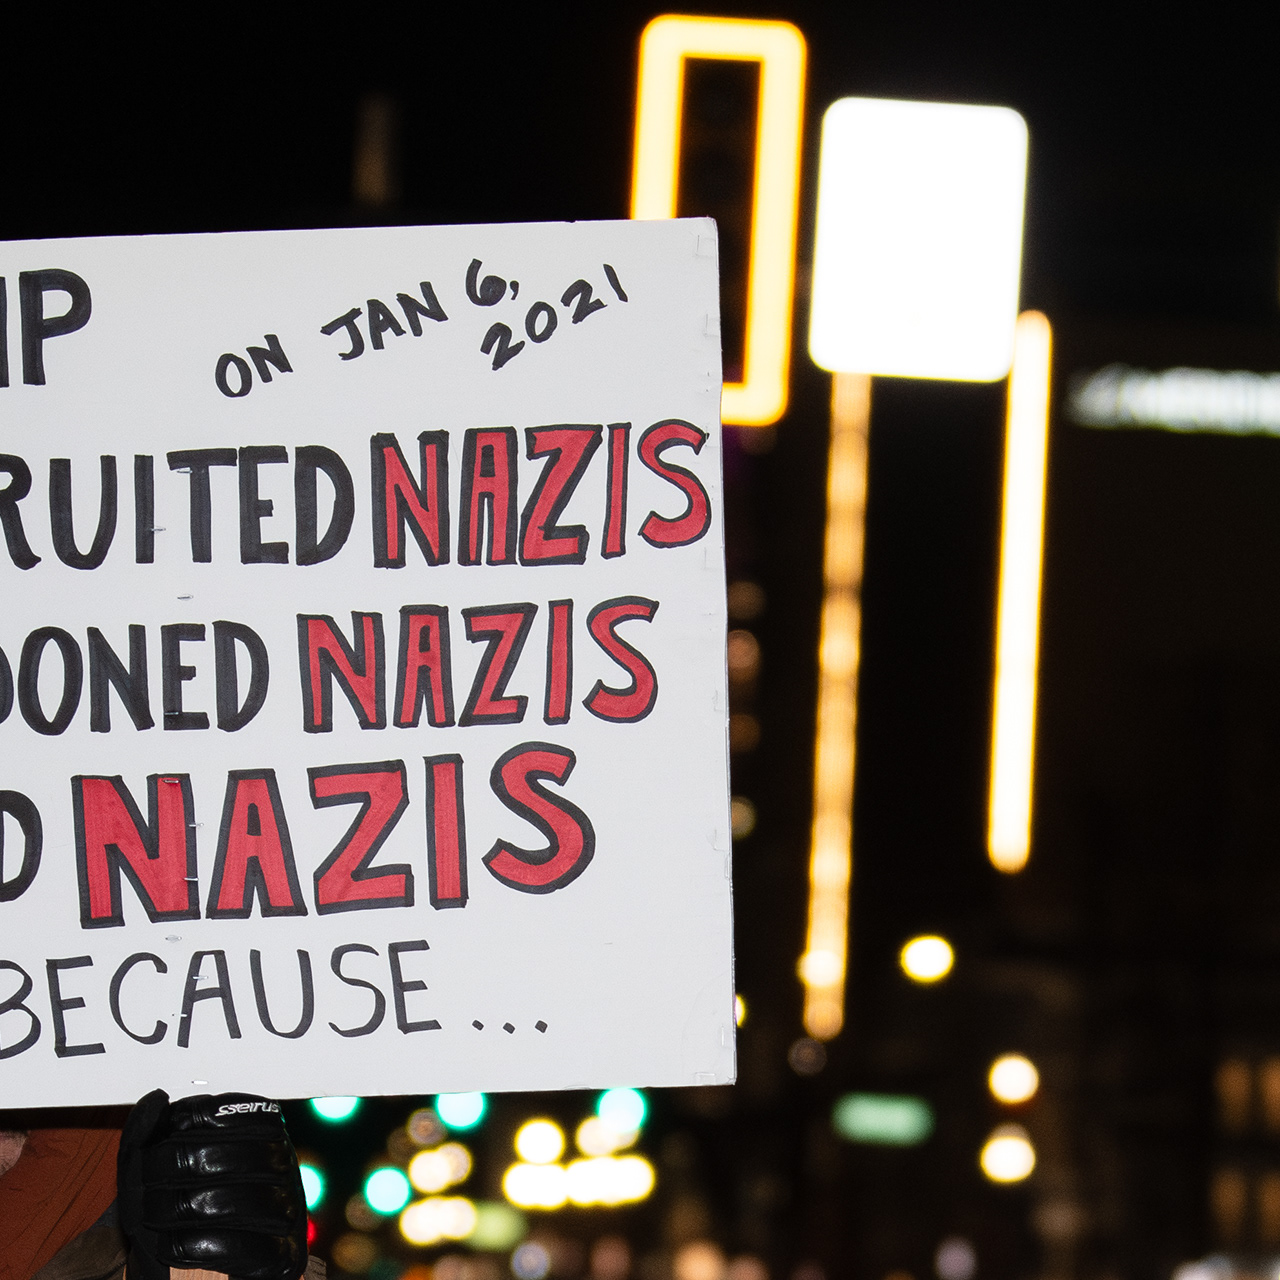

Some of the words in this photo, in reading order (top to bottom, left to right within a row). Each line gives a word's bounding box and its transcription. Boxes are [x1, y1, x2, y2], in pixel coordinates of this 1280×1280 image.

[215, 334, 293, 397] ON
[320, 282, 448, 360] JAN
[477, 262, 629, 371] 2021
[370, 419, 711, 569] NAZIS
[297, 596, 659, 733] NAZIS
[71, 742, 595, 929] NAZIS
